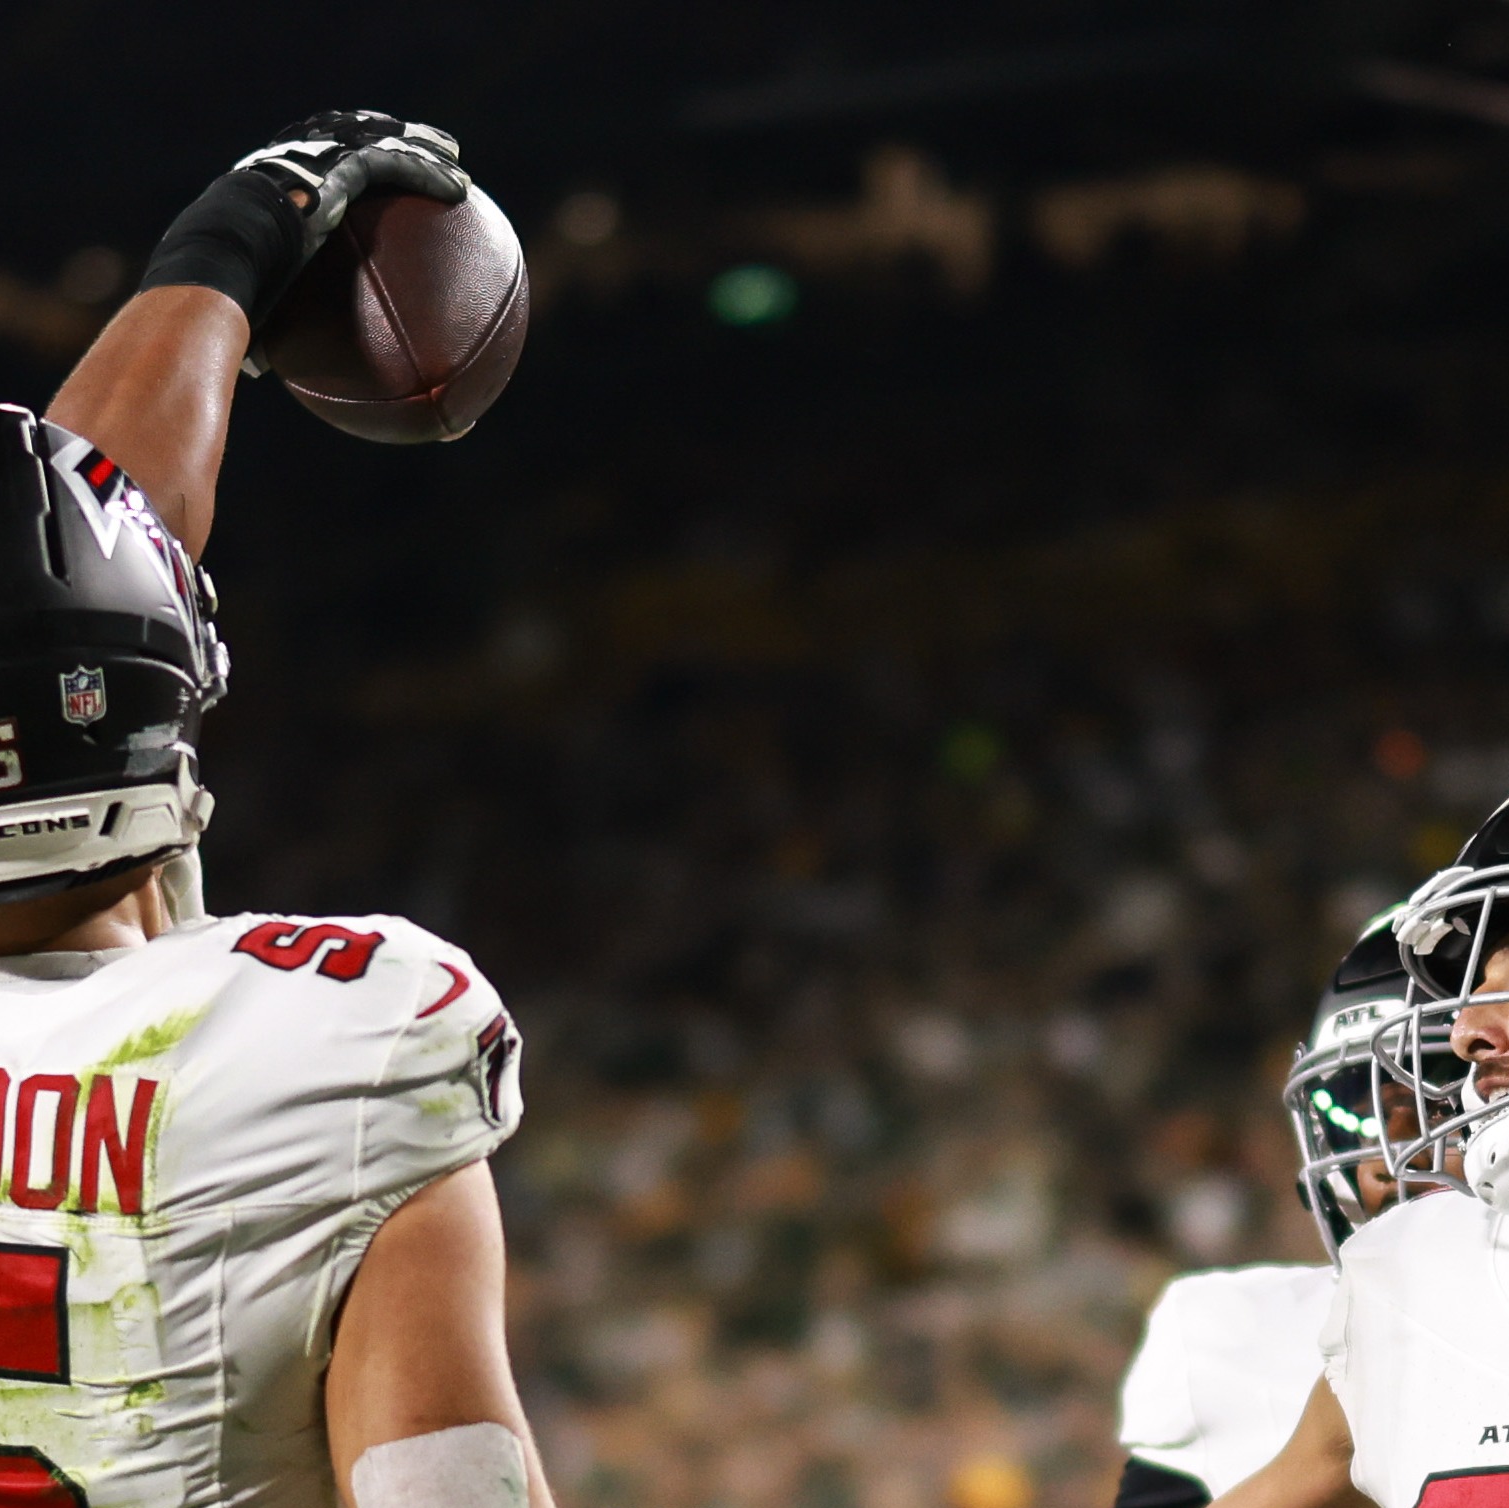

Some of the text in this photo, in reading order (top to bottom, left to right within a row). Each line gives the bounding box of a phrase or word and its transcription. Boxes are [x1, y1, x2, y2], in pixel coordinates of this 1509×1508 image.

[68, 692, 102, 717] NFL
[231, 921, 386, 983] 5
[1333, 1004, 1386, 1037] ATL
